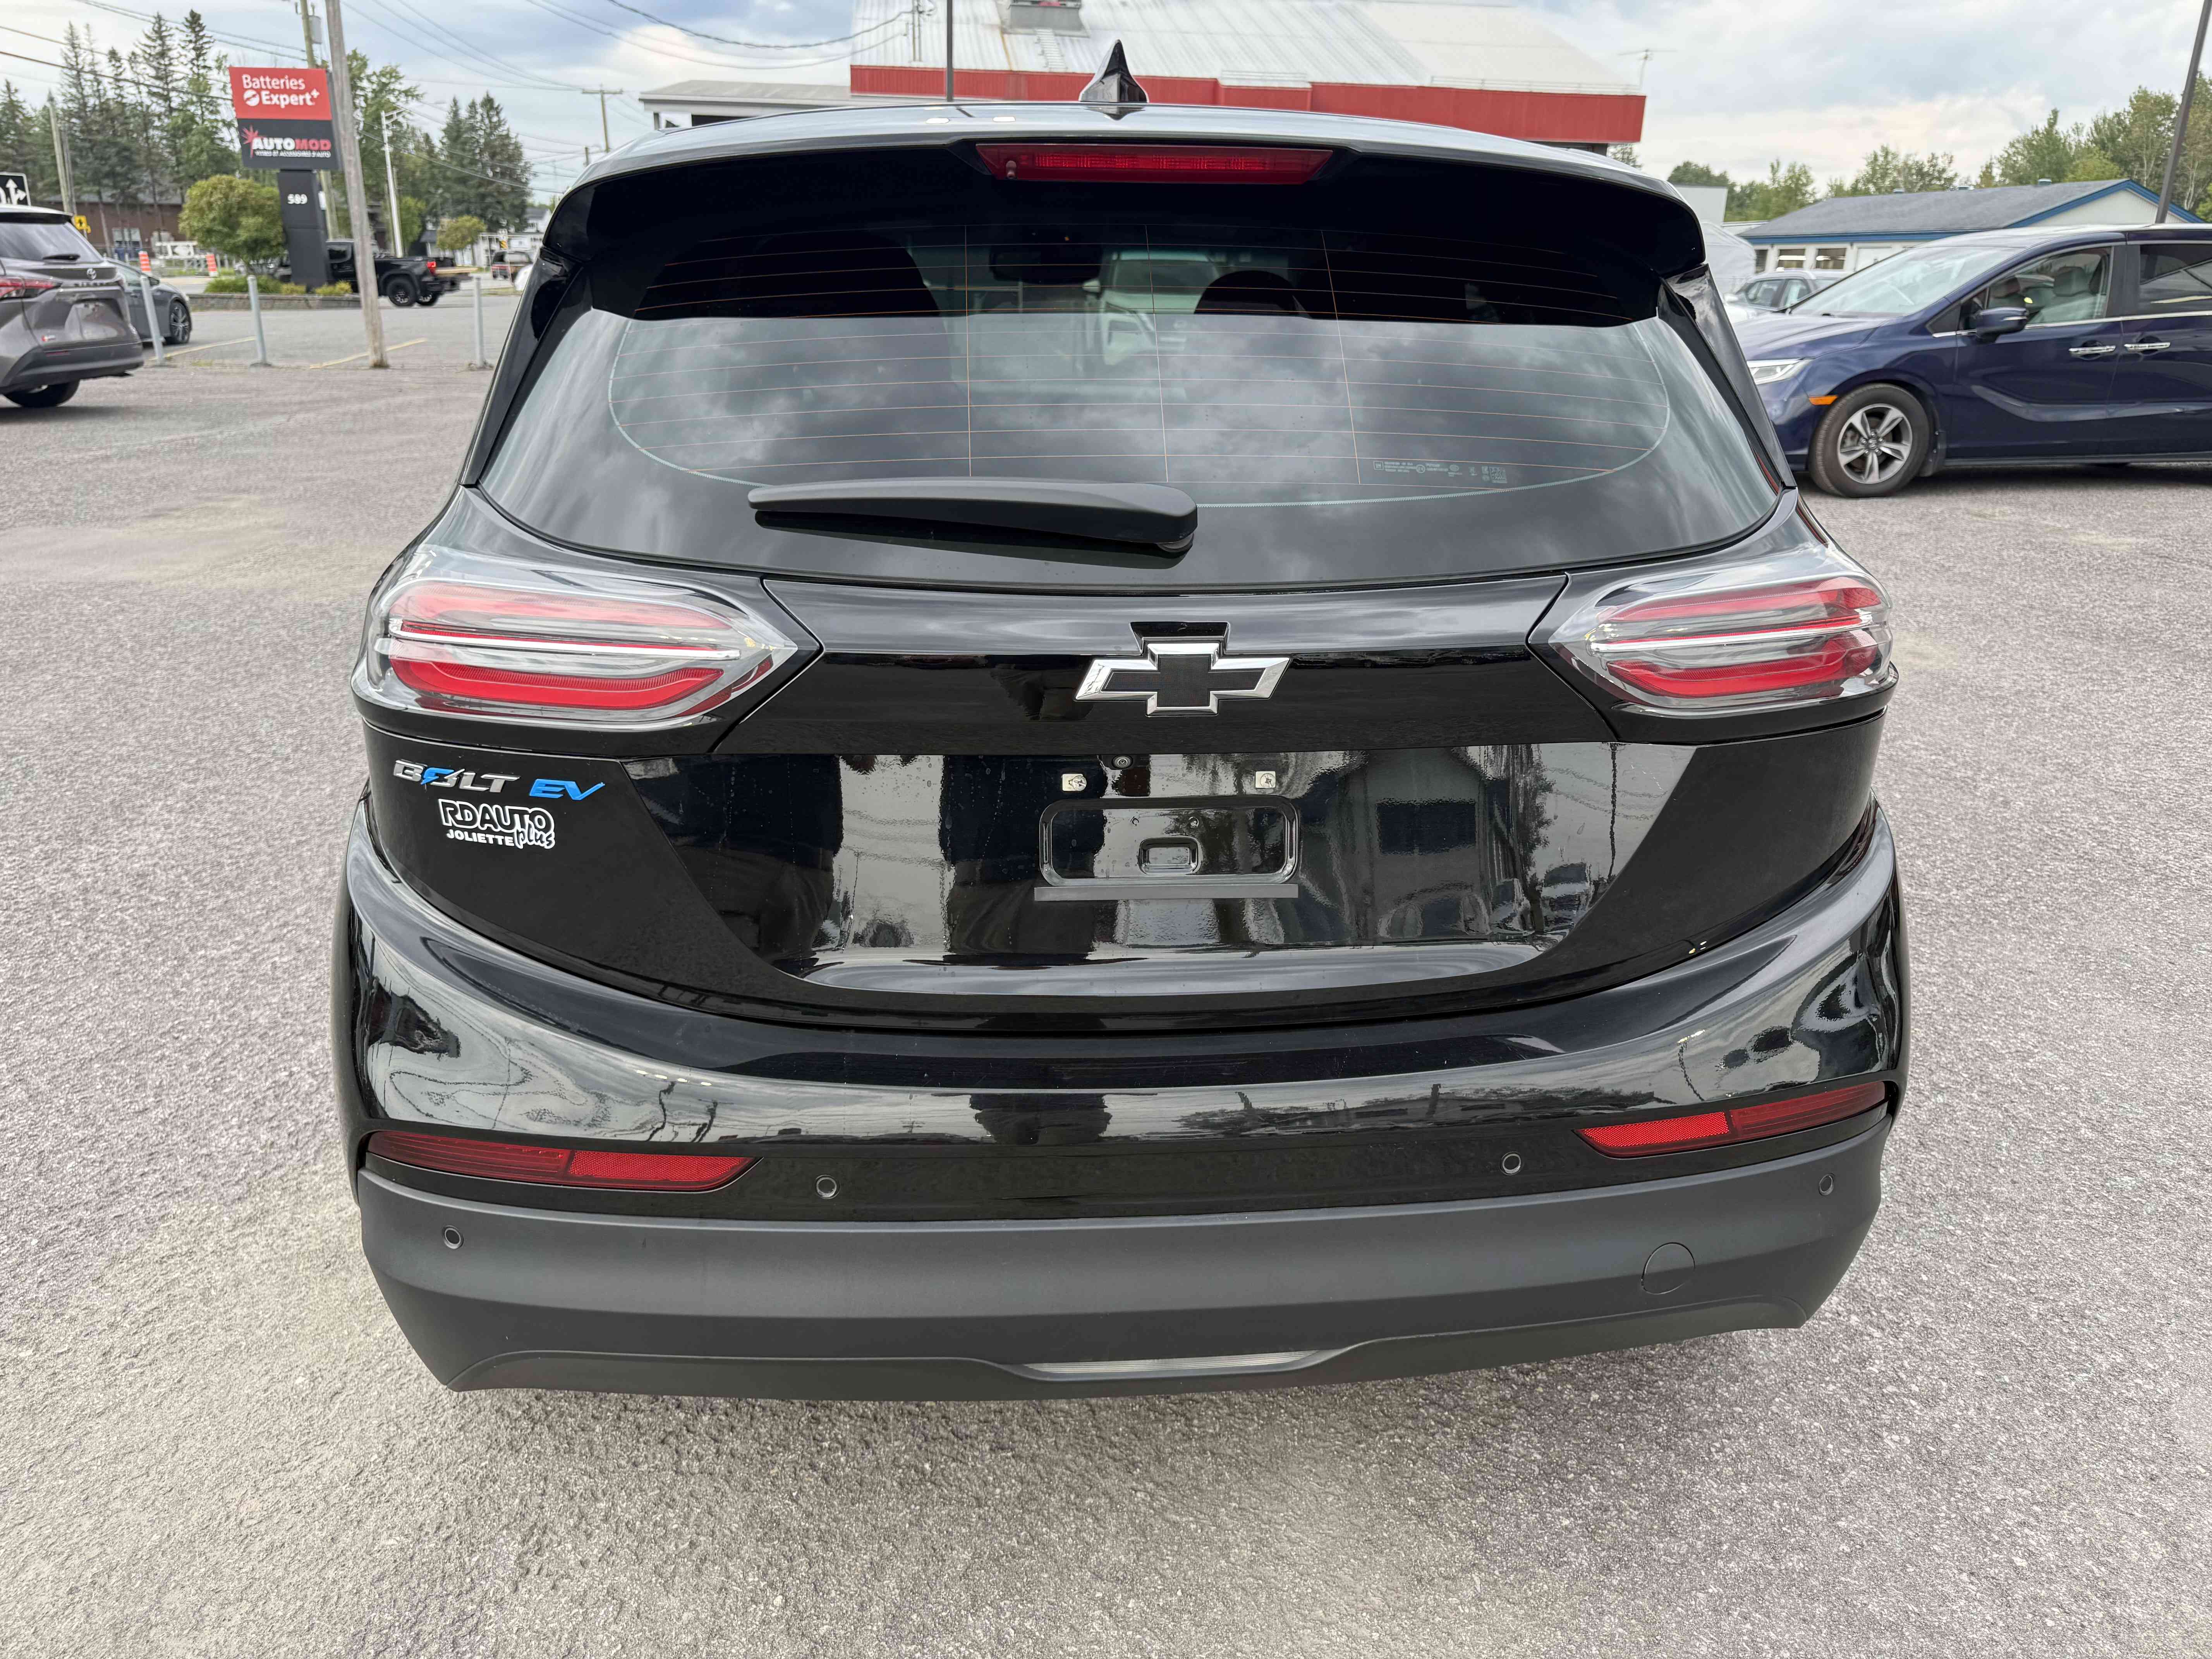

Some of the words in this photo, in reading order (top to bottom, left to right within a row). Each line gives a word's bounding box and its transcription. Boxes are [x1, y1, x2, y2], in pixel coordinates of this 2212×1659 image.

[242, 74, 306, 89] Batteries
[252, 137, 331, 150] AUTOMOD
[287, 194, 307, 204] 589
[393, 759, 520, 793] BOLT
[529, 778, 605, 800] EV
[446, 829, 515, 847] JOLIETTE
[514, 823, 556, 849] plus
